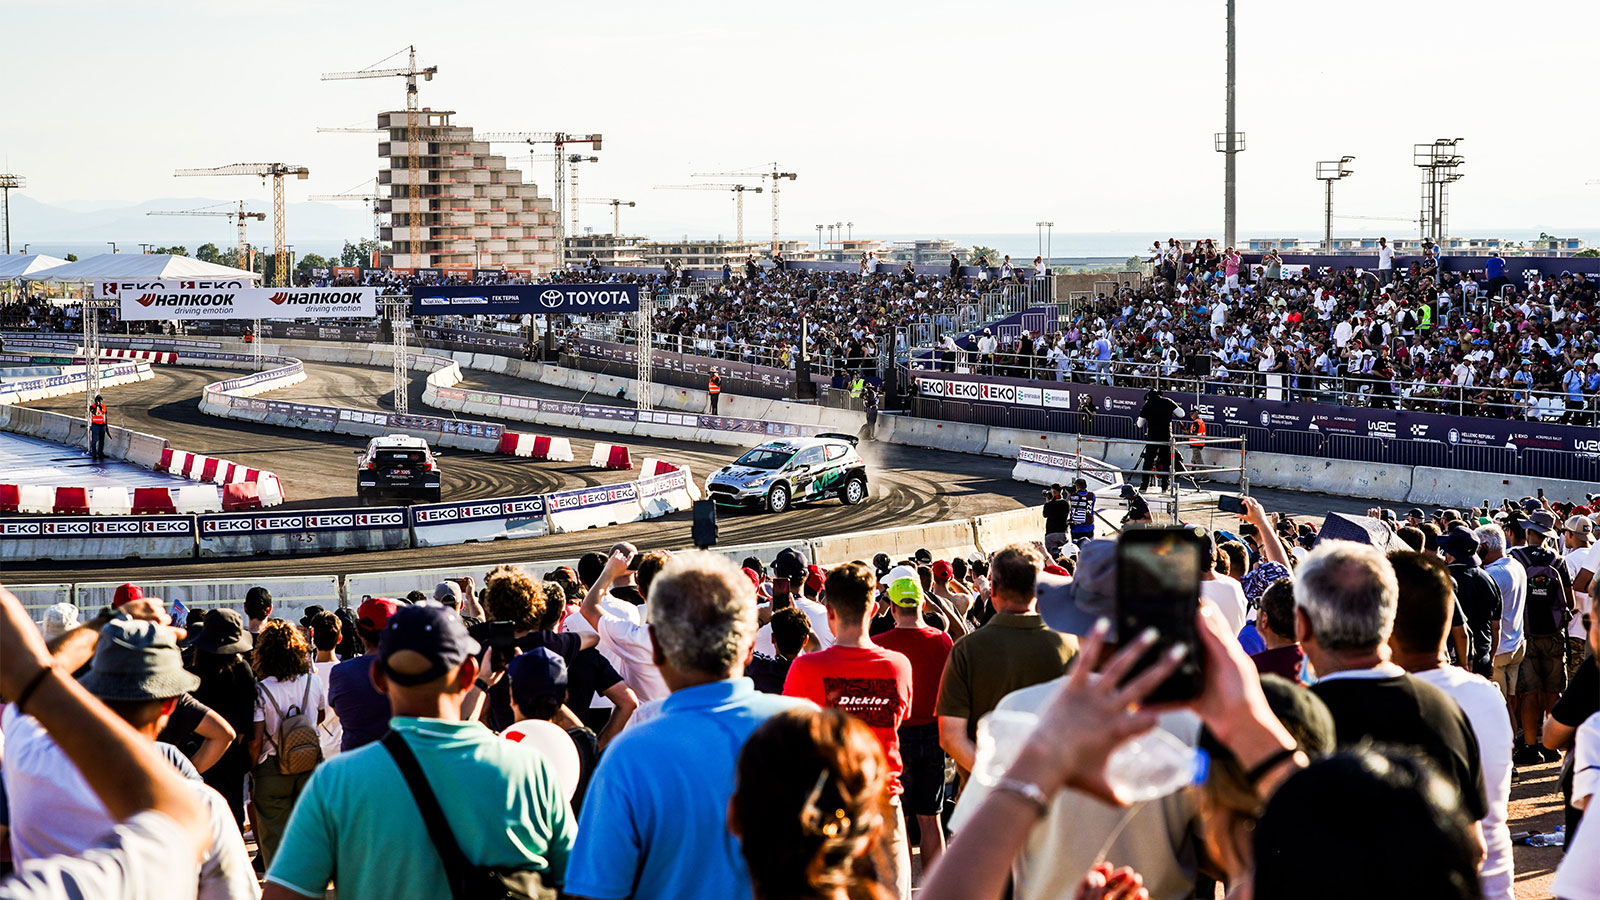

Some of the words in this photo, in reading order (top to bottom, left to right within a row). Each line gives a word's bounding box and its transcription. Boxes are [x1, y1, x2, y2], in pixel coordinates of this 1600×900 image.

[155, 294, 235, 306] HANKOOK
[287, 292, 362, 304] HANKOOK
[566, 291, 630, 305] TOYOTA
[922, 382, 943, 393] EKO
[955, 385, 977, 396] EKO
[991, 387, 1014, 400] EKO
[1368, 420, 1396, 432] WRC
[1574, 439, 1600, 452] WR
[559, 497, 578, 507] EKO
[588, 492, 606, 503] EKO
[616, 488, 635, 498] EKO
[430, 510, 457, 519] EKO
[473, 505, 500, 515] EKO
[515, 502, 542, 512] EKO
[7, 524, 38, 533] EKO
[57, 524, 88, 532] EKO
[107, 523, 138, 532] EKO
[157, 522, 188, 531] EKO
[219, 520, 251, 530] EKO
[270, 518, 302, 527] EKO
[320, 516, 352, 525] EKO
[371, 514, 402, 523] EKO
[838, 696, 890, 705] Dickies
